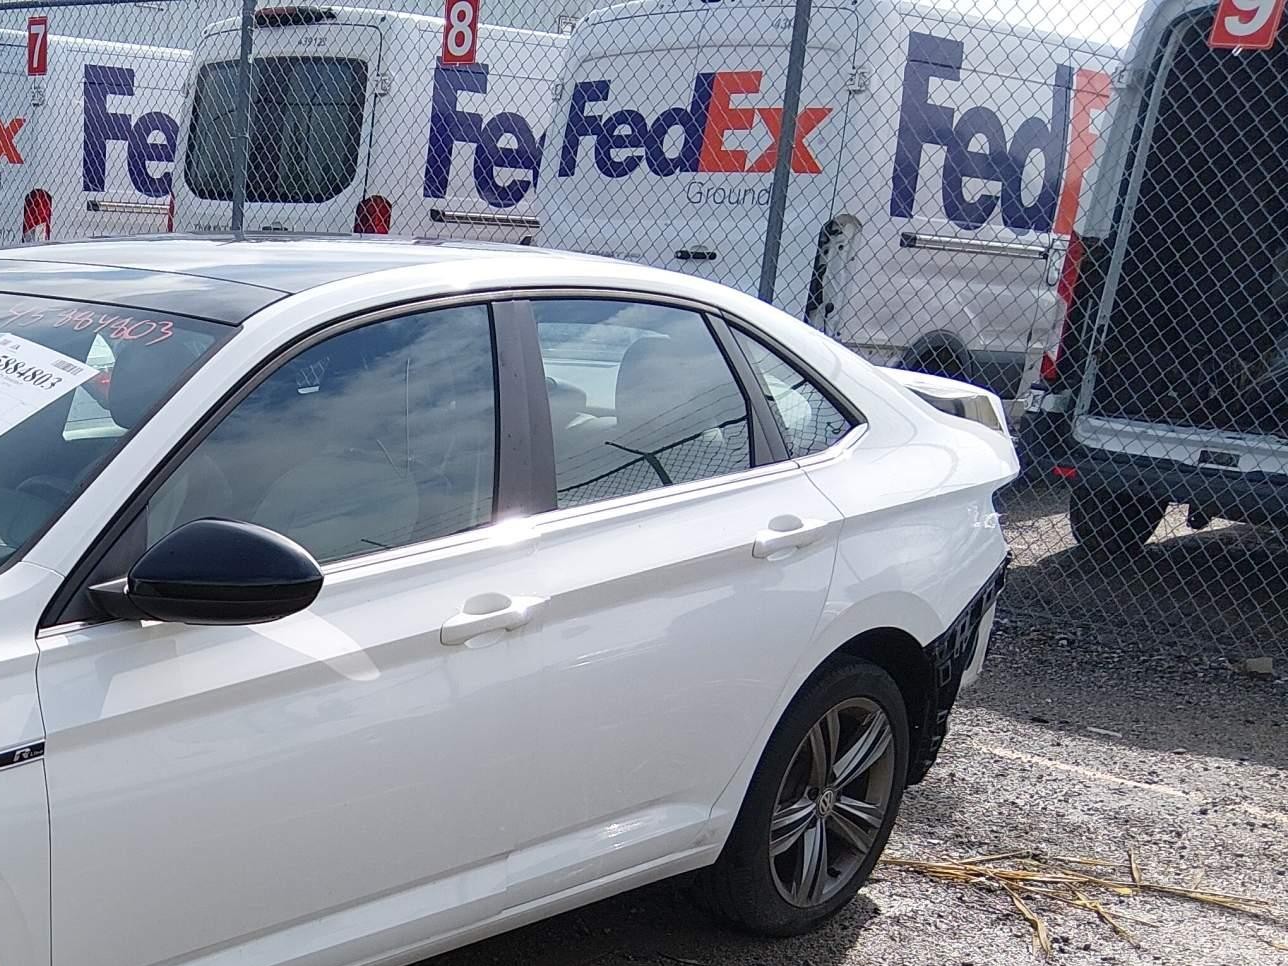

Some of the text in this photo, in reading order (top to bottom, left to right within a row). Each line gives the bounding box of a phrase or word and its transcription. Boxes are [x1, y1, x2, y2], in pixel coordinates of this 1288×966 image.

[447, 1, 473, 56] 8
[1224, 0, 1277, 36] 9
[30, 25, 45, 68] 7
[558, 71, 833, 178] FedEx
[686, 181, 774, 205] Ground
